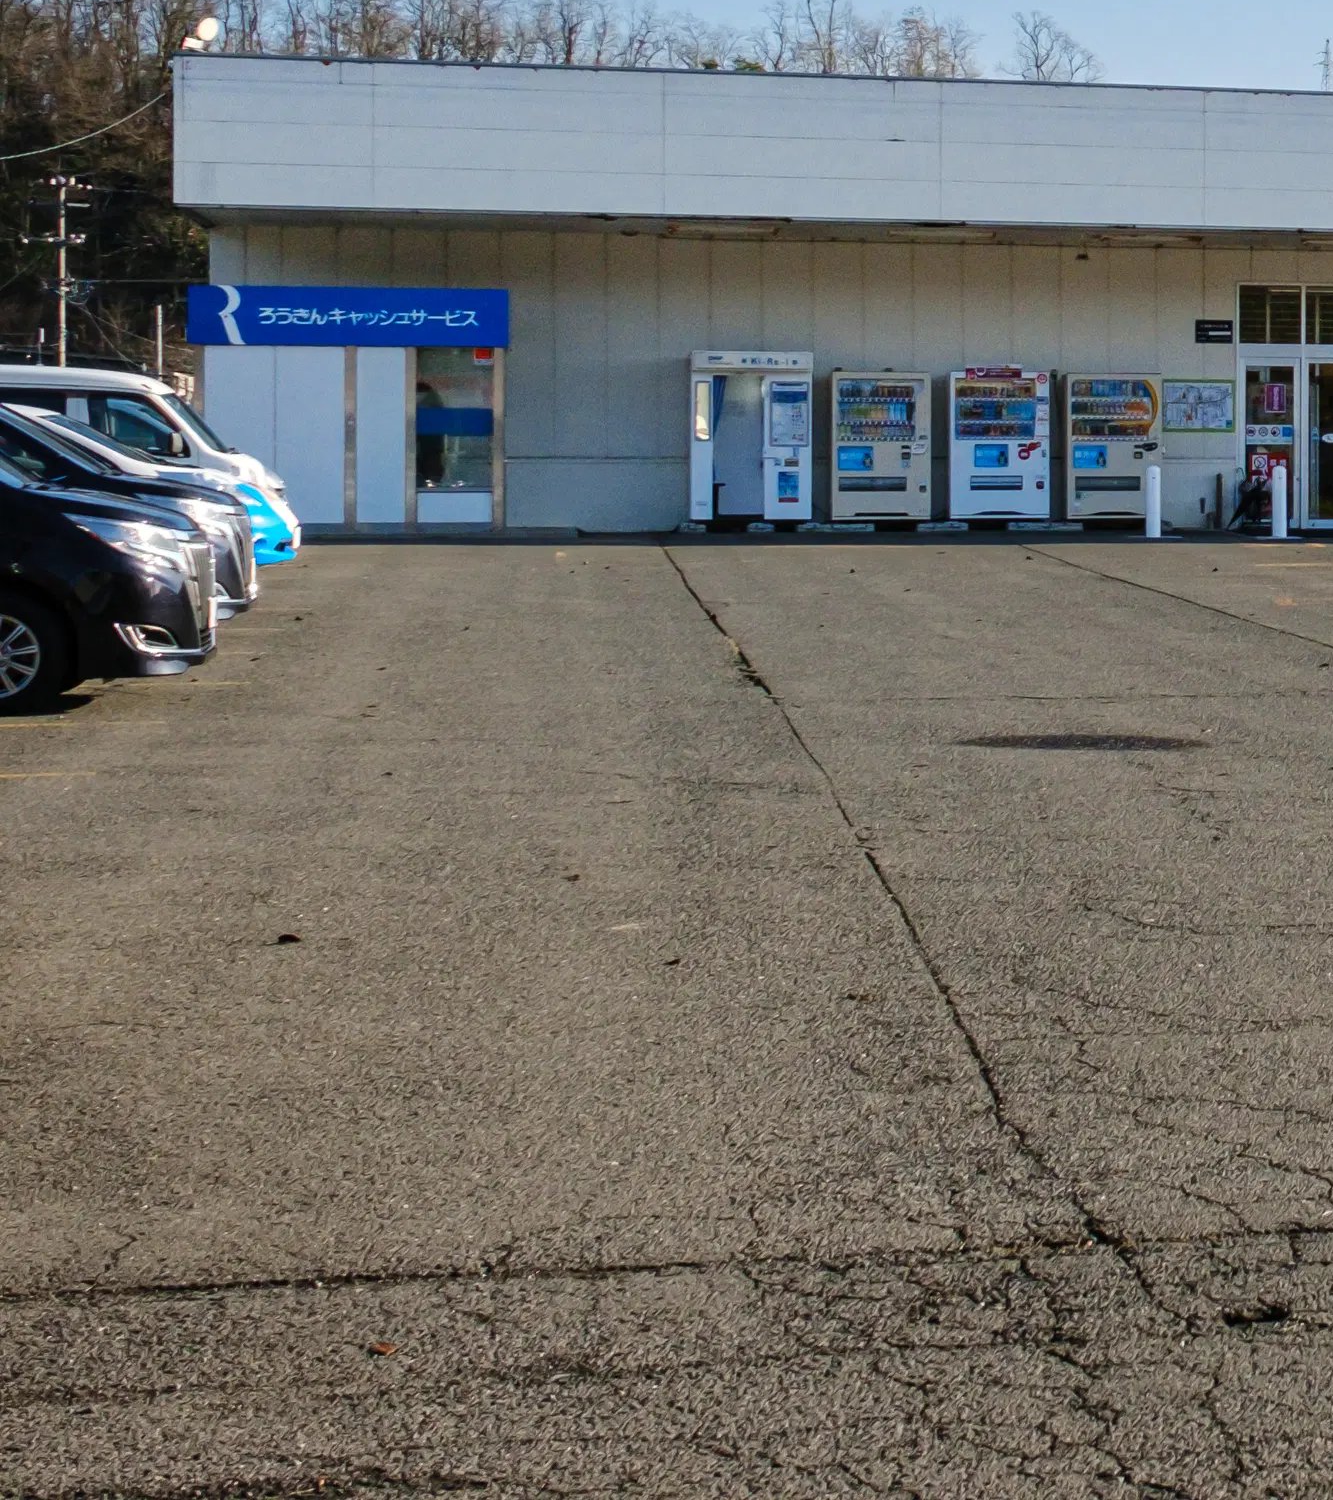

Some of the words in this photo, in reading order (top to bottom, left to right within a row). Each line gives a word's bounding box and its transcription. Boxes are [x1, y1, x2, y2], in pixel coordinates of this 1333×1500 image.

[258, 307, 479, 326] ろうきんキャッシュサービス
